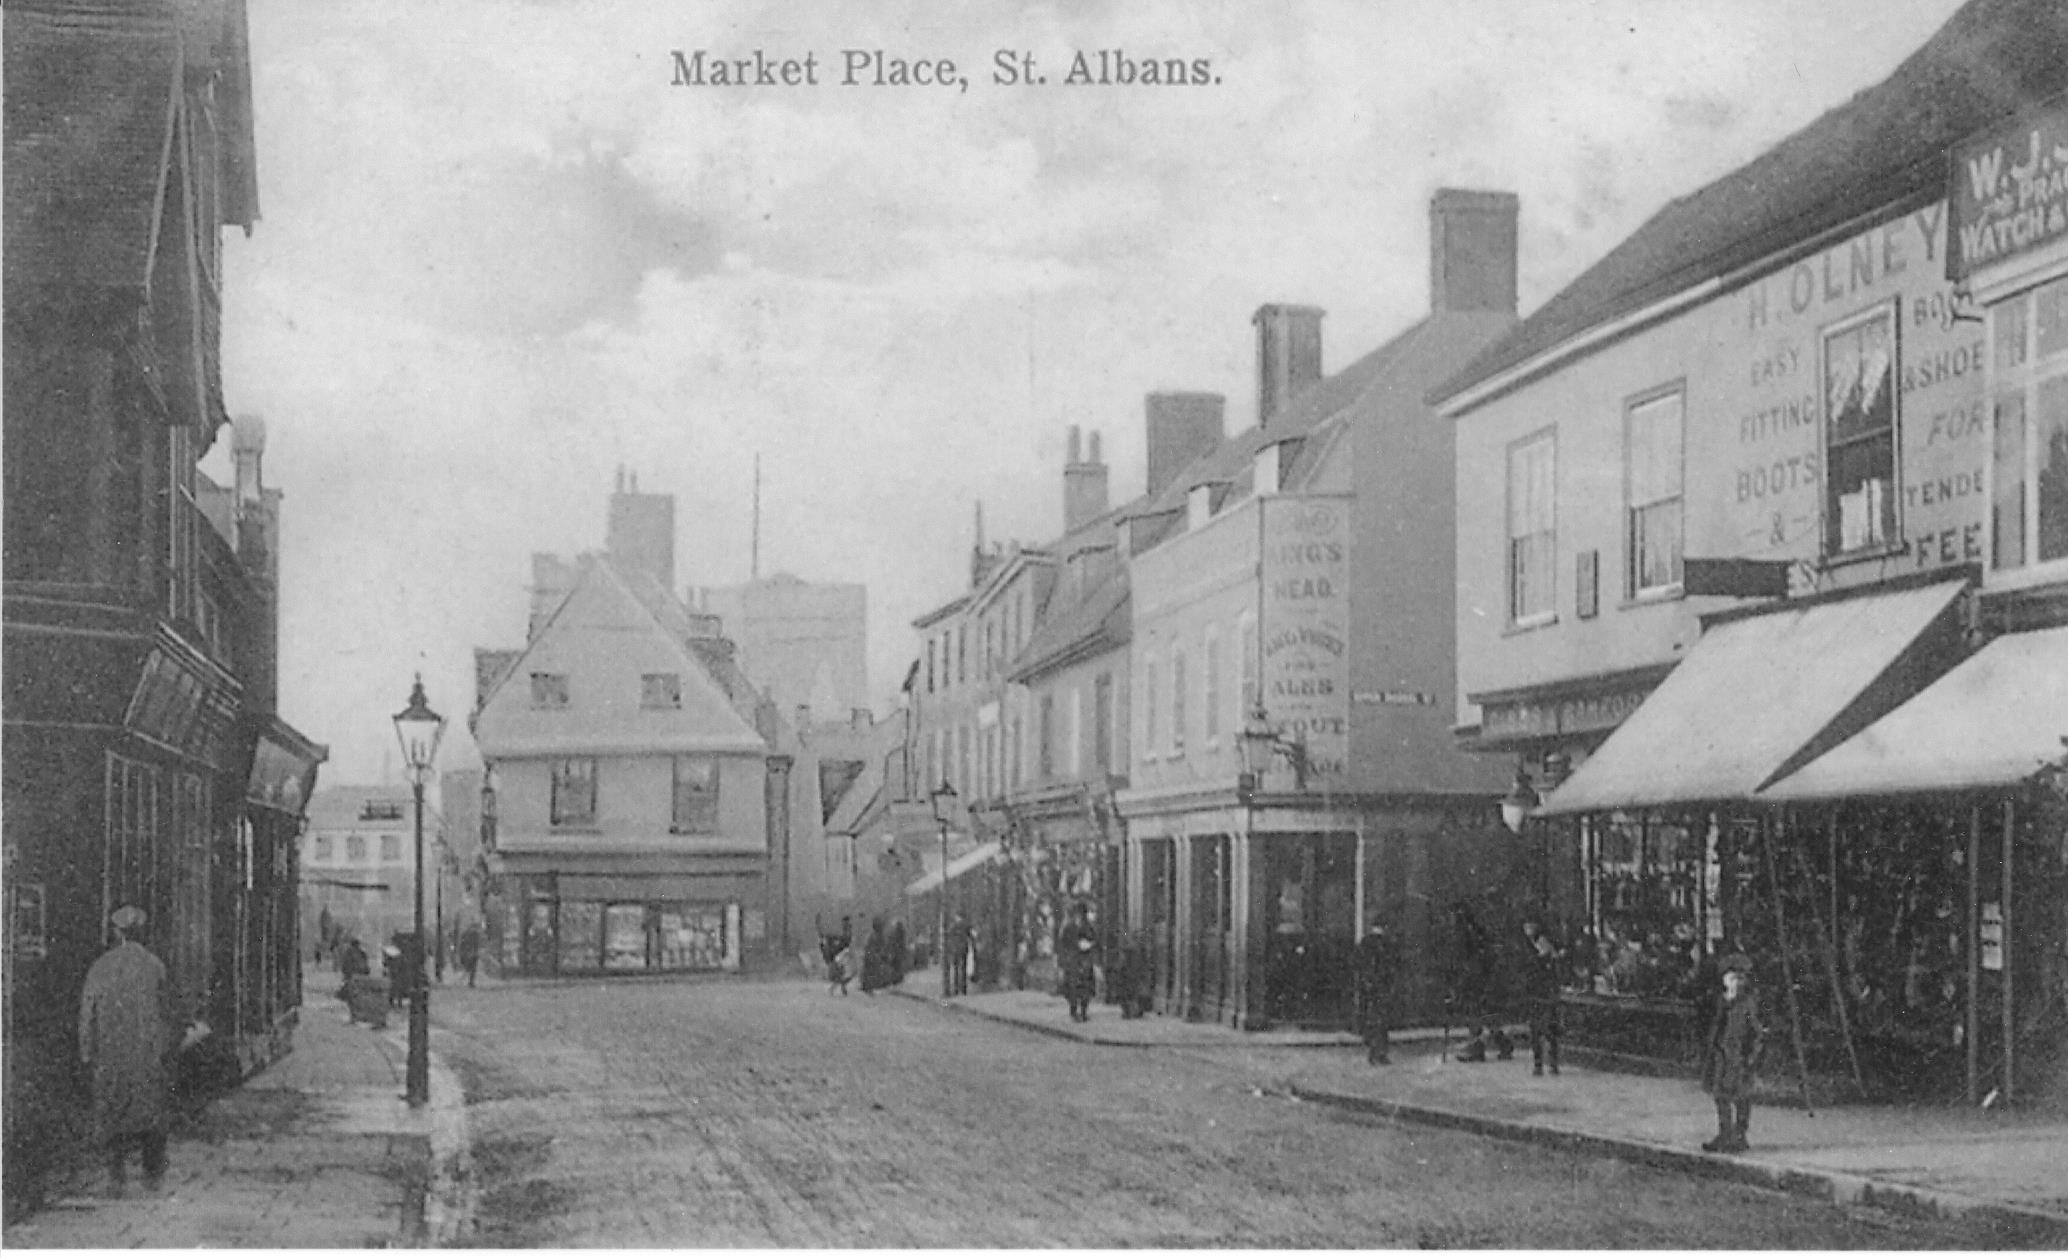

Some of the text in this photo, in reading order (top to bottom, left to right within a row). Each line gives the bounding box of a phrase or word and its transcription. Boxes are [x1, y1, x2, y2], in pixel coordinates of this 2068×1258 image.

[1791, 200, 1945, 315] OLNEY
[1959, 206, 2045, 262] WATCH
[1751, 348, 1800, 388] EASY
[1740, 394, 1816, 444] FITTING
[1737, 453, 1817, 503] BOOTS
